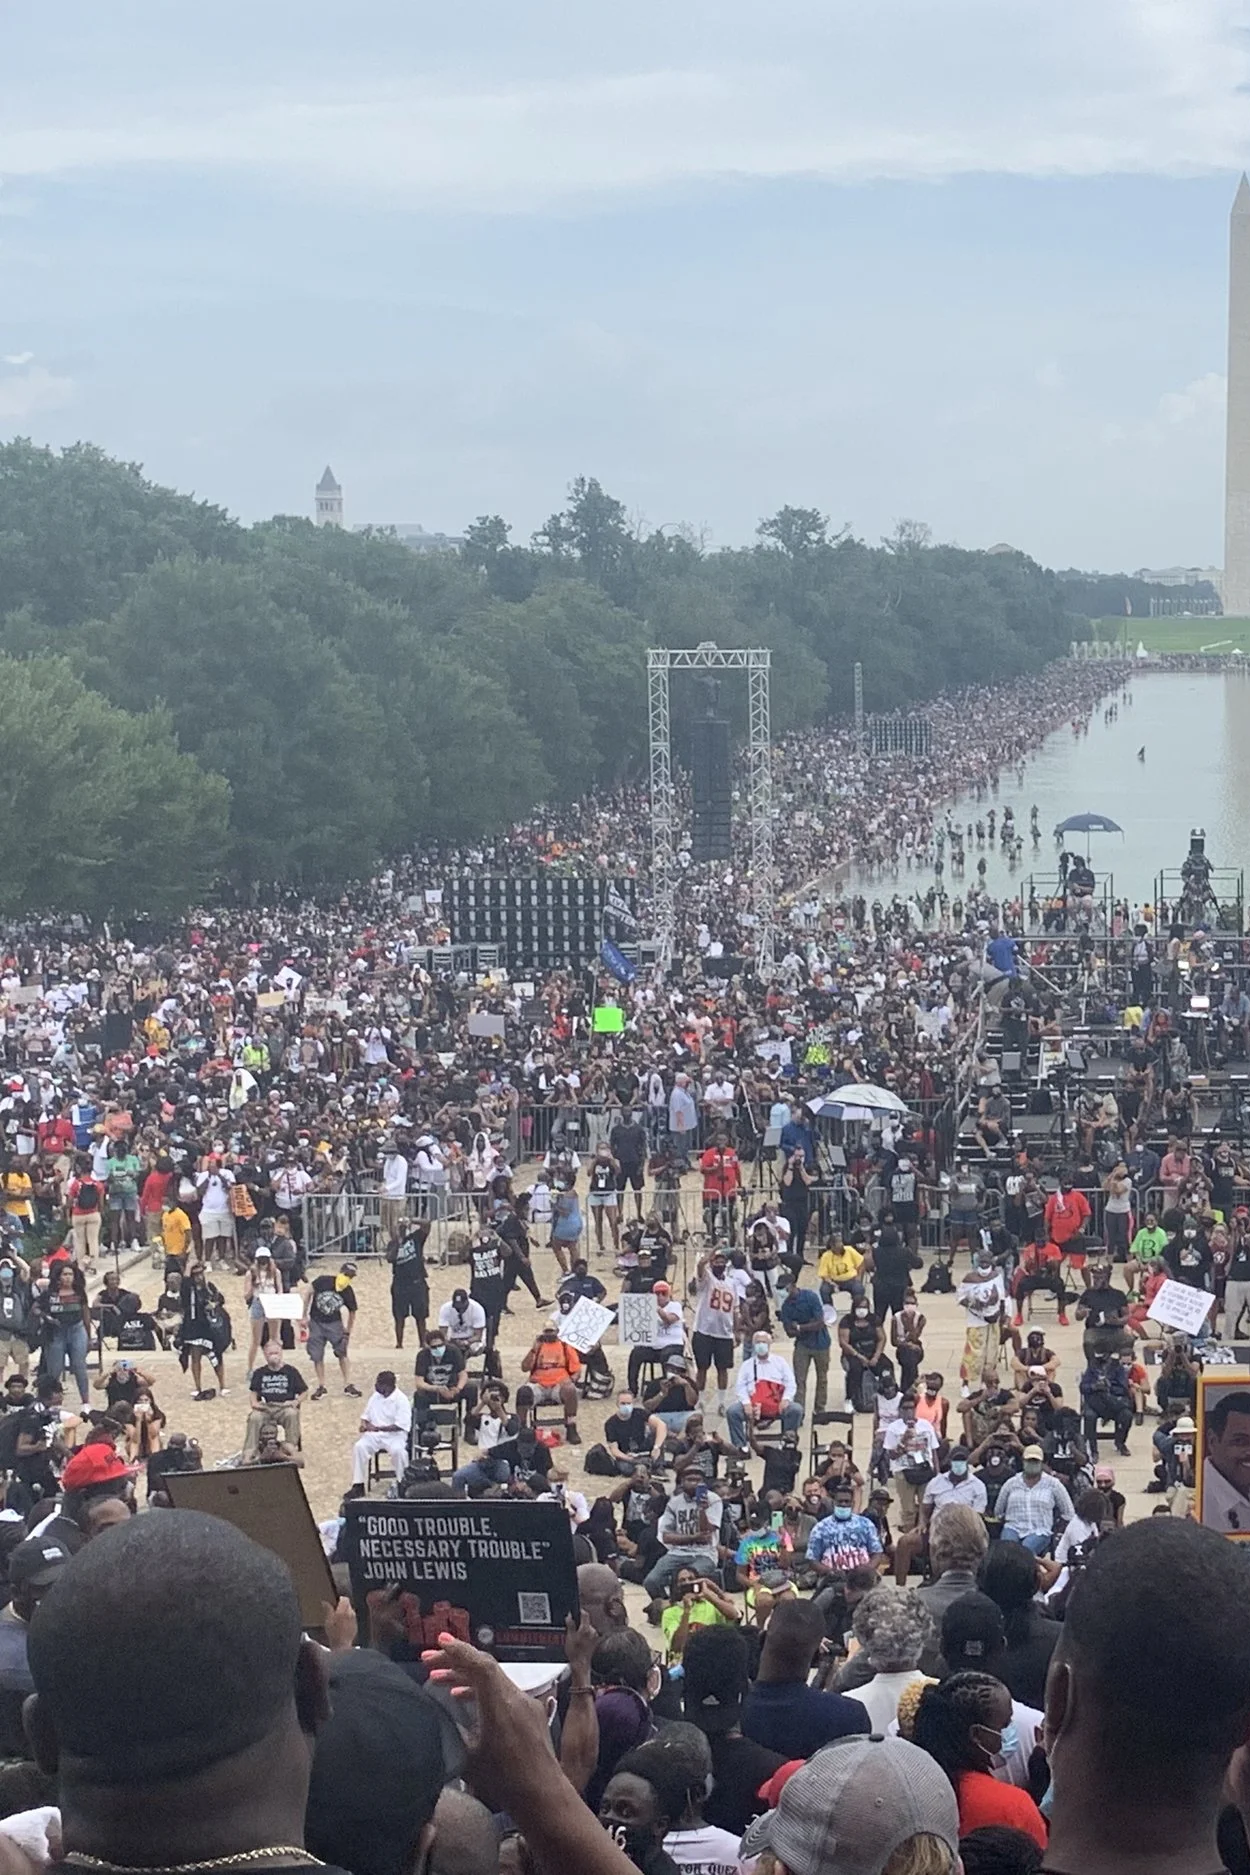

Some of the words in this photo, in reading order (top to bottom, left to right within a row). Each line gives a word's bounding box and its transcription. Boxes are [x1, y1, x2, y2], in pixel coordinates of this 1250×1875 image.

[1142, 1239, 1156, 1259] B
[710, 1288, 735, 1313] 89
[123, 1320, 144, 1329] ASL
[624, 1330, 652, 1343] VOTE
[360, 1539, 460, 1559] NECESSARY
[364, 1562, 407, 1580] JOHN
[413, 1562, 468, 1581] LEWIS
